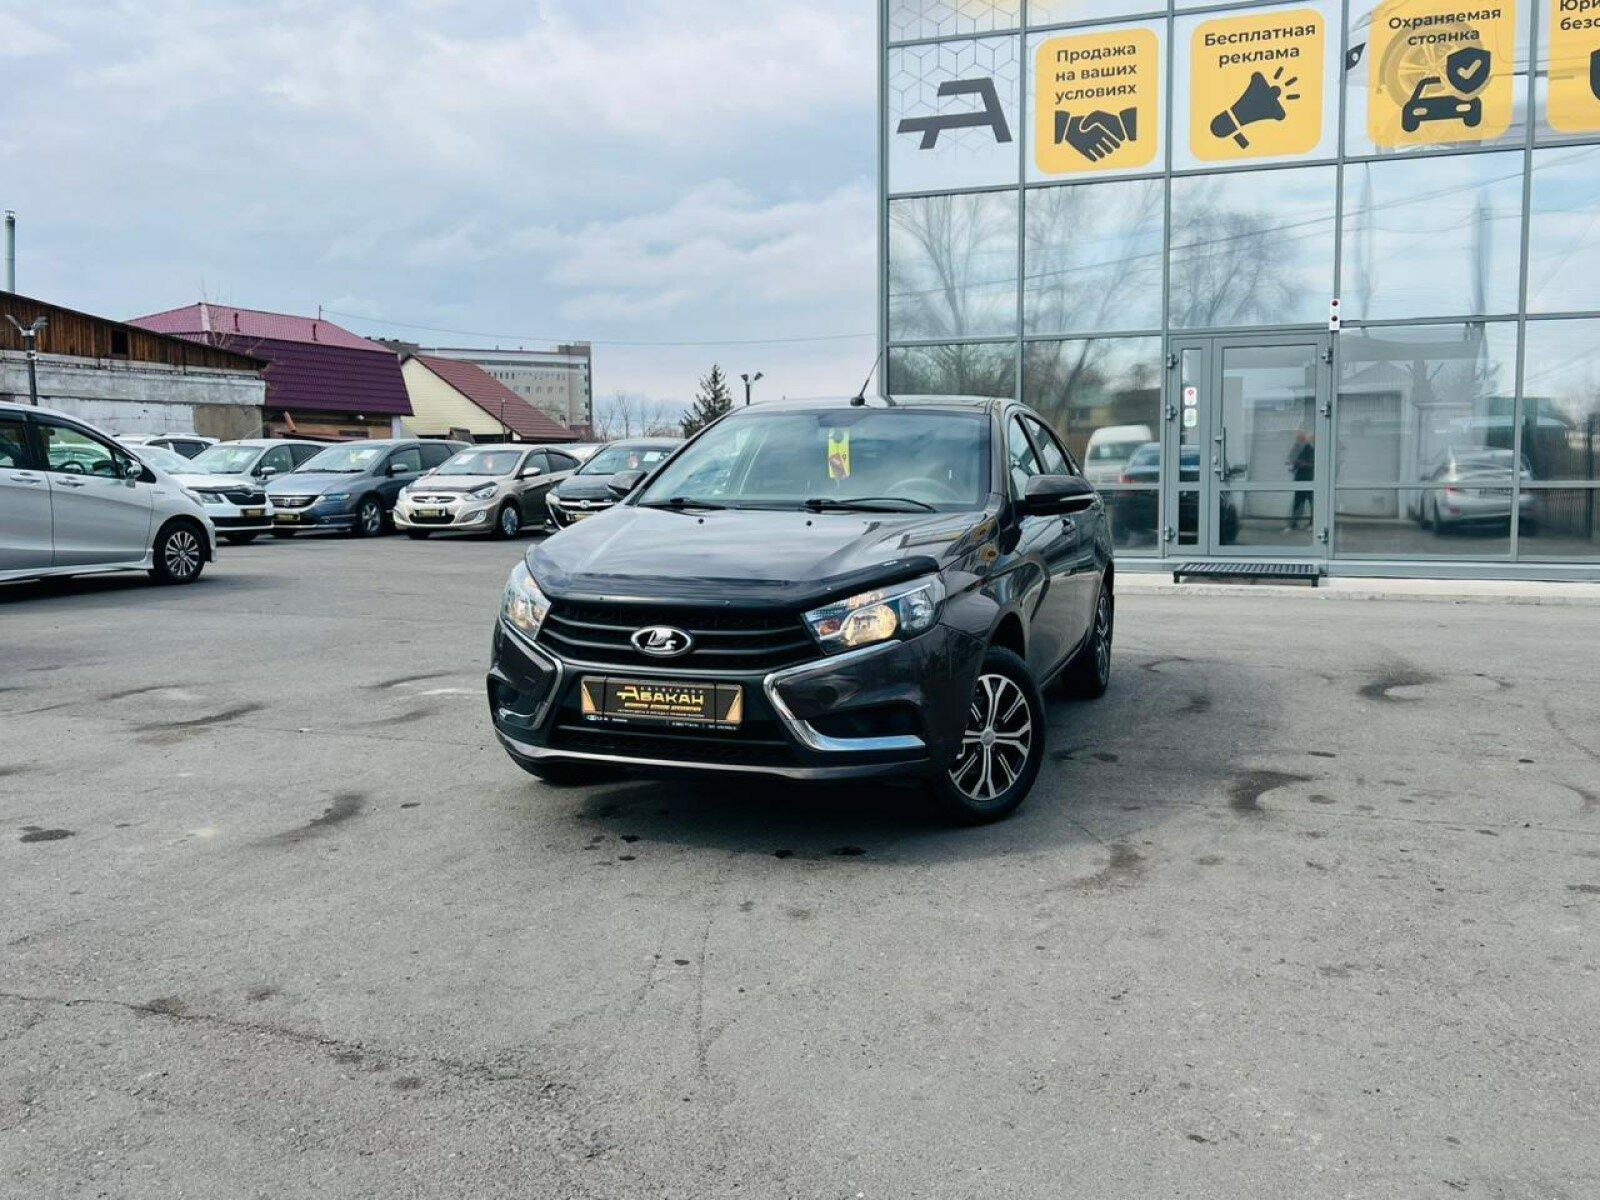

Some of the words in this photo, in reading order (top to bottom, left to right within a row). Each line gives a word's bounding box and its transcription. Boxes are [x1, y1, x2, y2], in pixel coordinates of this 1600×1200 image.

[1389, 8, 1501, 29] Охраняемая
[1204, 24, 1316, 46] Бесплатная
[1408, 29, 1480, 46] стоянка
[1056, 44, 1136, 64] Продажа
[1219, 46, 1300, 68] реклама
[1055, 70, 1076, 82] на
[1080, 64, 1137, 79] ваших
[1055, 84, 1137, 105] условиях
